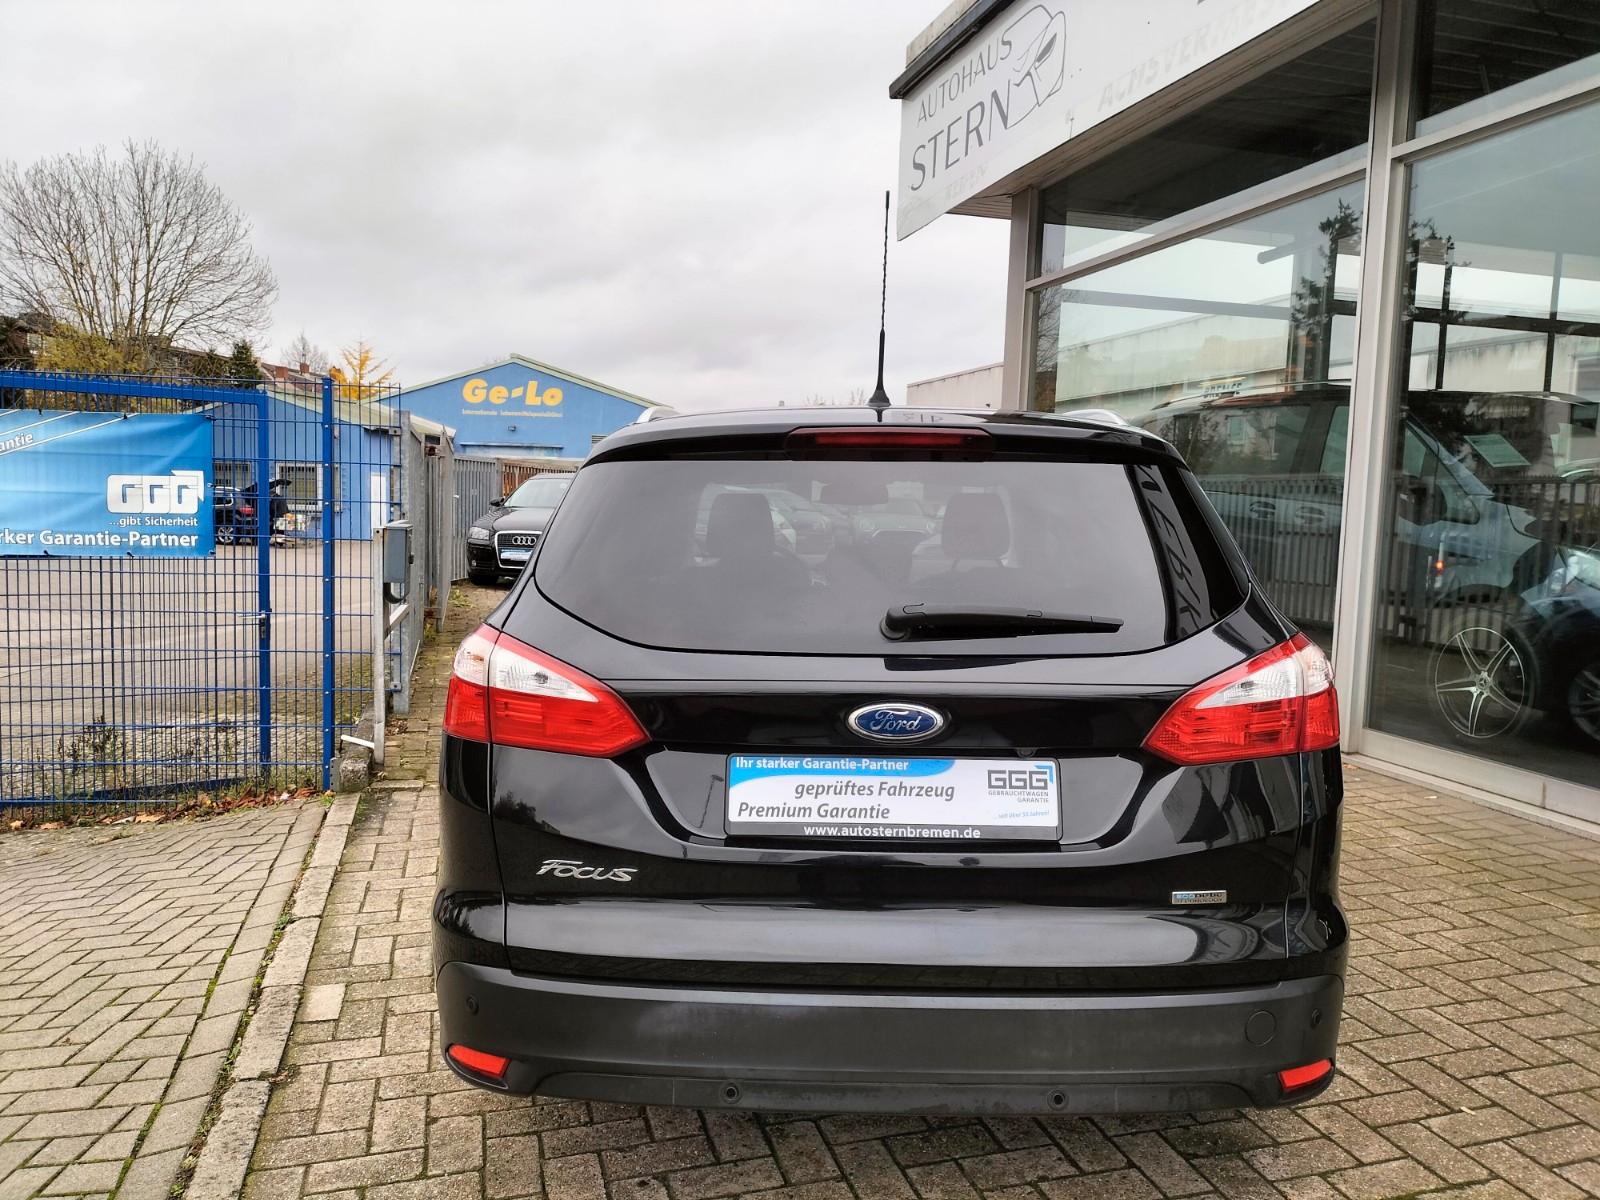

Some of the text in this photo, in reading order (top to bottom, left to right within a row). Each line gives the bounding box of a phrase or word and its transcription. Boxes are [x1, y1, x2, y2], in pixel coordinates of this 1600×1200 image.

[917, 34, 1013, 127] AUTOHAUS
[910, 79, 1010, 191] STERN
[462, 378, 563, 406] Ge-Lo
[107, 473, 200, 514] GGG
[145, 516, 198, 527] Sicherheit
[40, 530, 199, 546] Garantie-Partner
[869, 708, 922, 732] Ford
[736, 757, 909, 771] Ihr starker Garantie-Partner
[987, 769, 1049, 790] GGG
[795, 780, 955, 801] geprüftes Fahrzeug
[738, 802, 890, 819] Premium Garantie
[803, 824, 981, 839] www.autosternbremen.de
